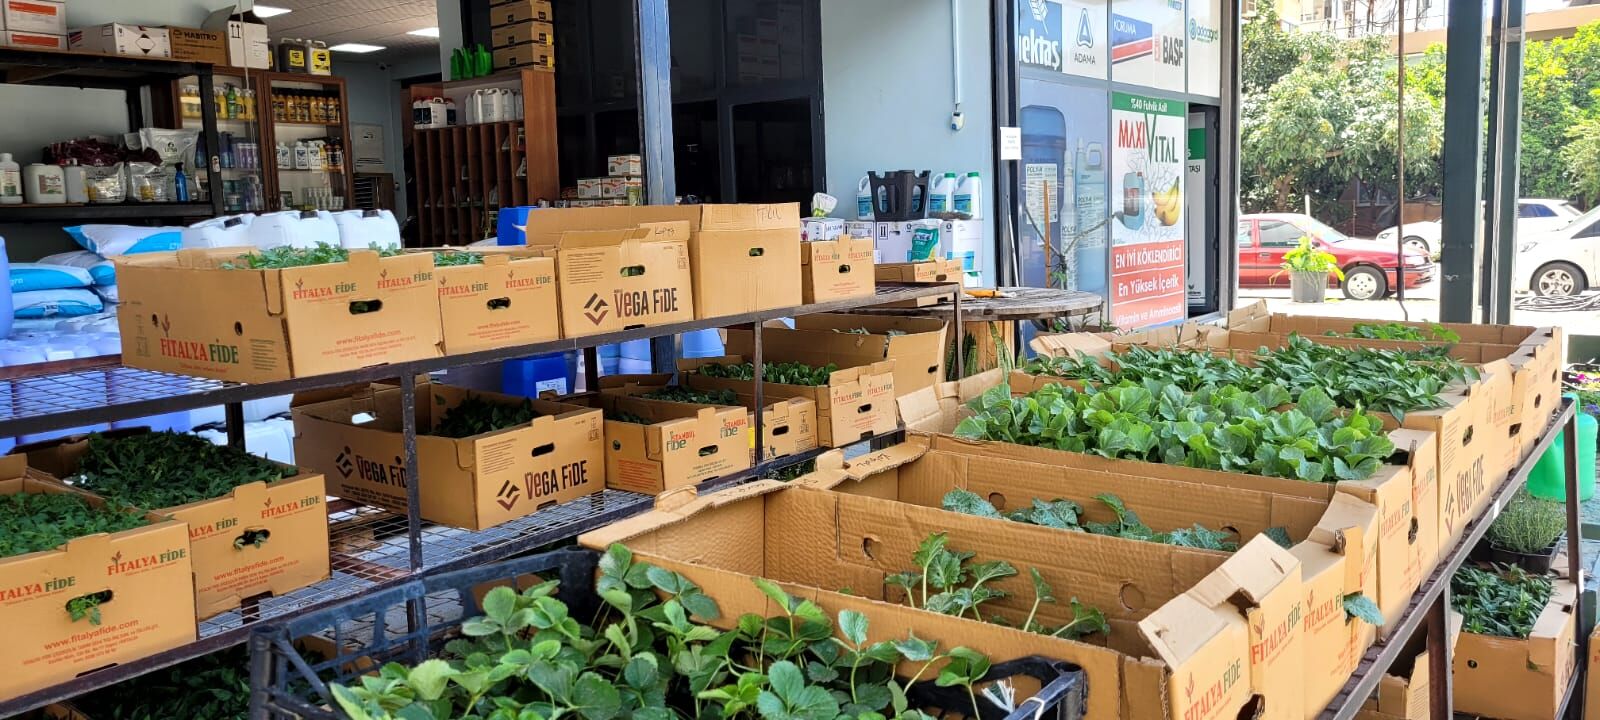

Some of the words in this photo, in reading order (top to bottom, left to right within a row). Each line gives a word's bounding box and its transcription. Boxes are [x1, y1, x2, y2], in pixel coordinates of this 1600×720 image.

[1073, 51, 1097, 65] ADAMA
[1162, 34, 1184, 67] BASF
[1115, 253, 1126, 269] EN
[1118, 282, 1129, 297] En
[1130, 276, 1158, 295] Yüksek
